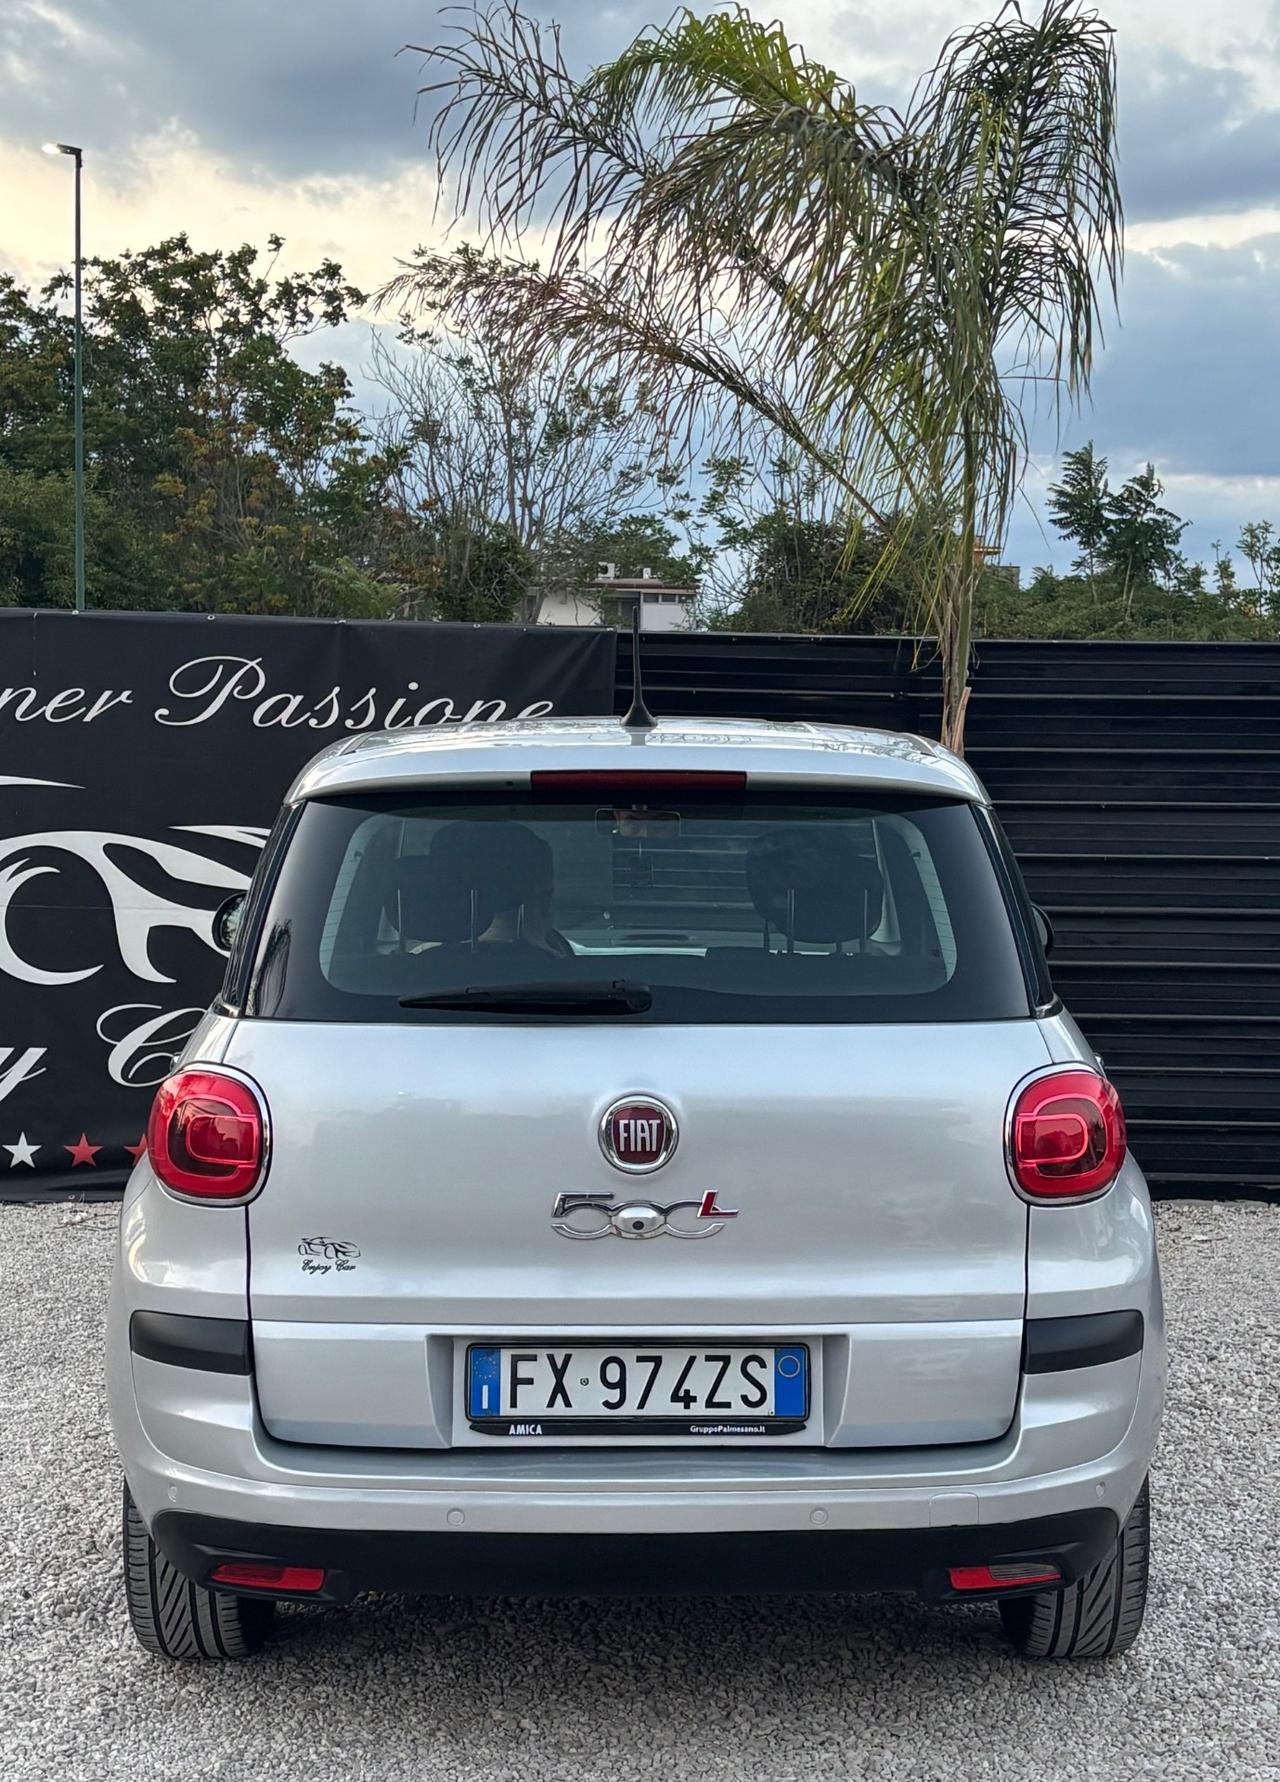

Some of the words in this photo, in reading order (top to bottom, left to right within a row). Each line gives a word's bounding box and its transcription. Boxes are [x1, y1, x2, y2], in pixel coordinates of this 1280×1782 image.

[0, 687, 133, 722] ner
[154, 655, 554, 730] Passione
[618, 1119, 661, 1152] FIAT
[301, 1259, 332, 1275] Enjoy
[335, 1259, 356, 1272] Car
[509, 1353, 573, 1408] FX
[508, 1424, 543, 1435] AMICA
